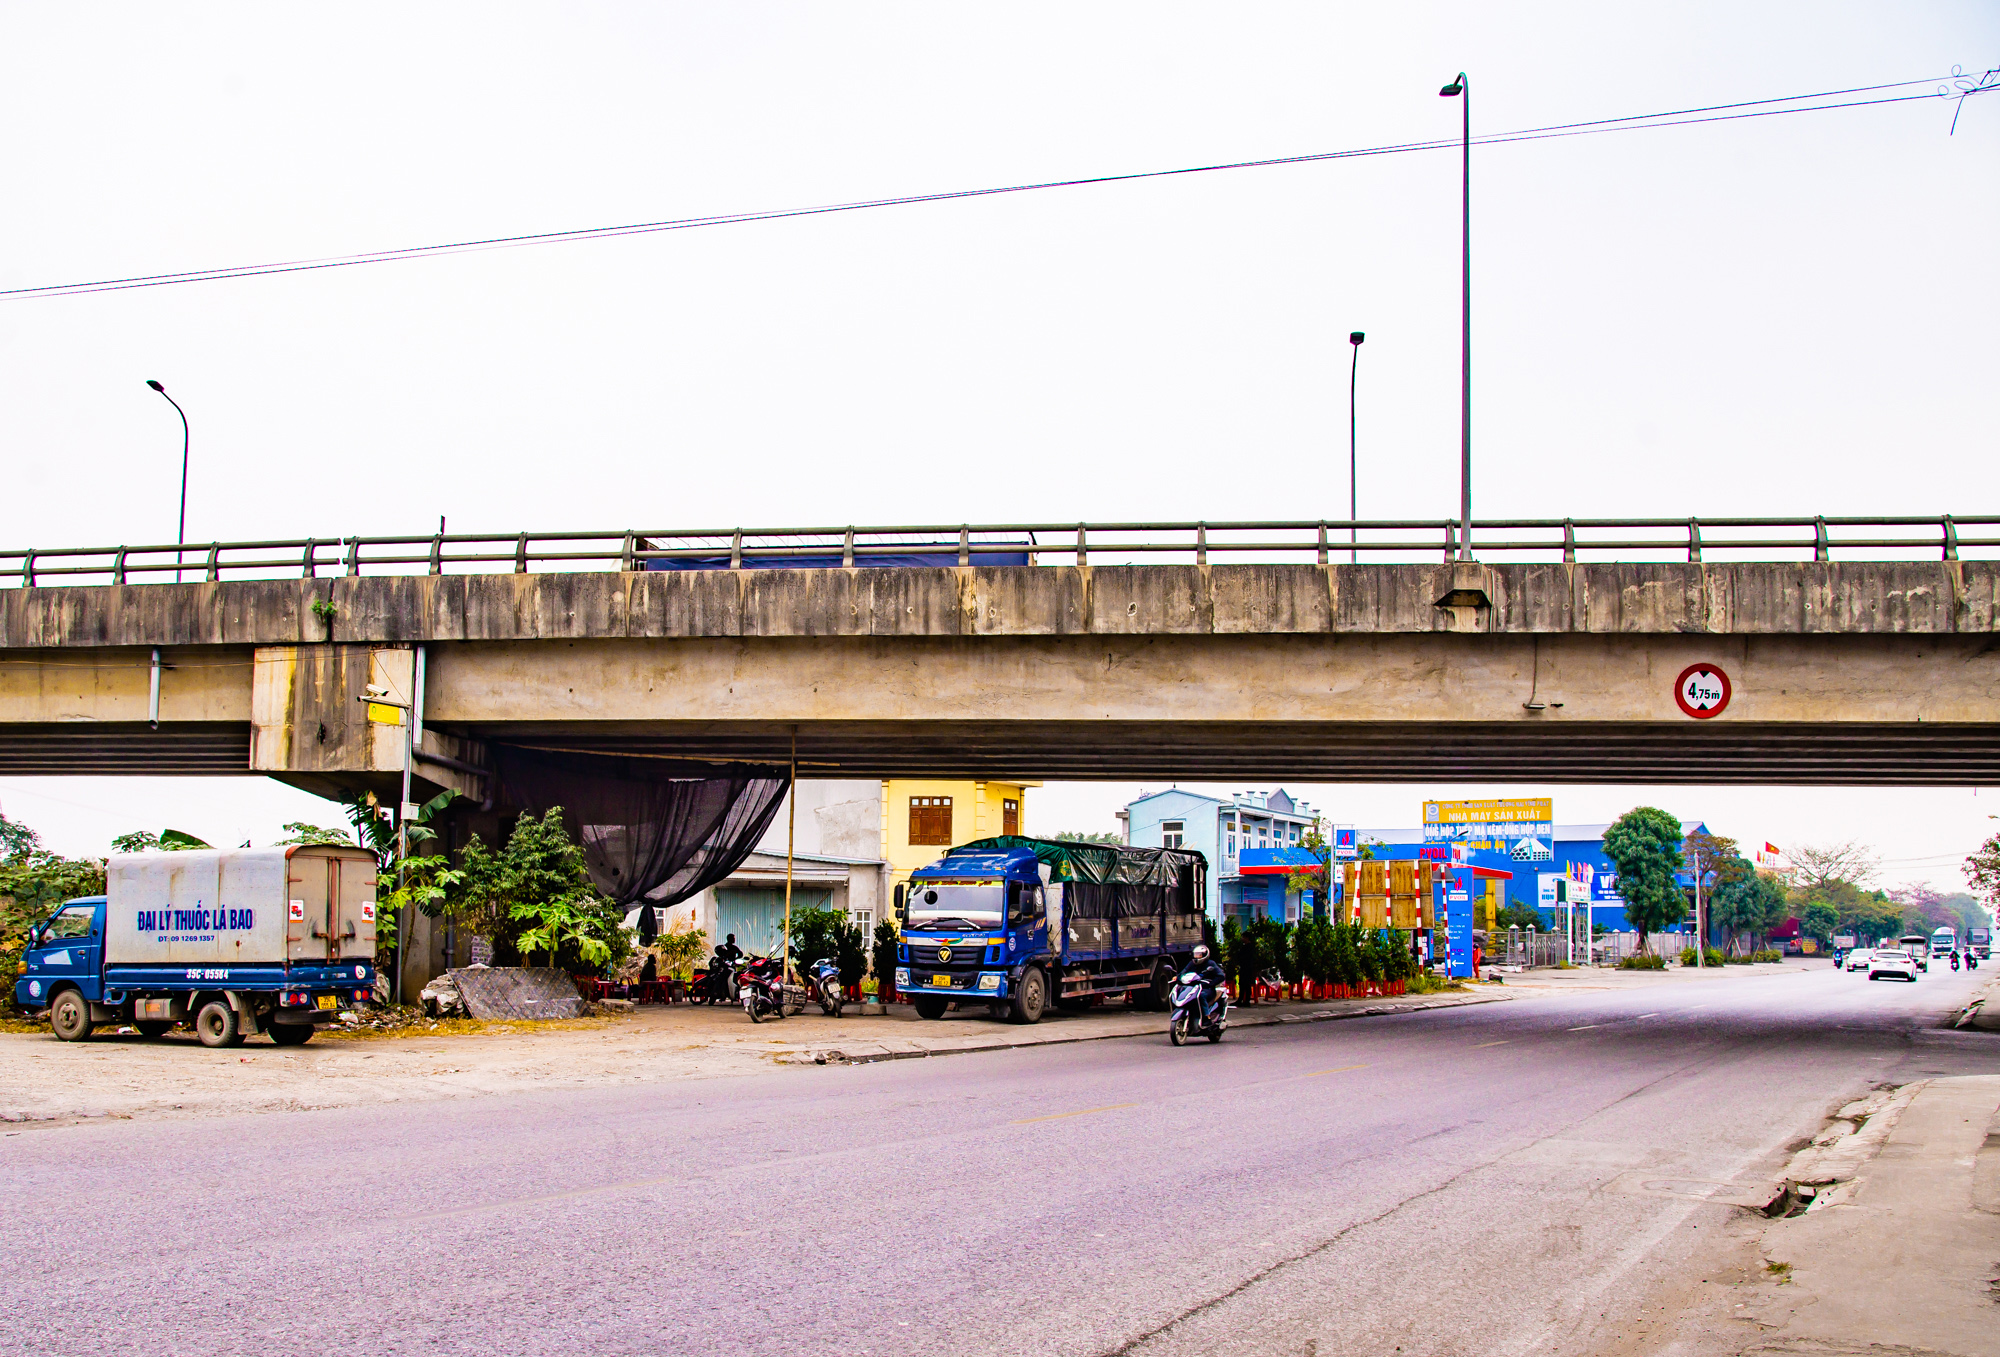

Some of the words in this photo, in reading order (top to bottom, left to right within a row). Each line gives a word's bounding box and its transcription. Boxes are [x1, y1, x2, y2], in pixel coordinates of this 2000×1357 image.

[1420, 848, 1448, 859] PVOIL
[137, 911, 157, 933] ĐẠI
[159, 904, 172, 931] LÝ
[174, 899, 211, 931] THUỐC
[213, 904, 227, 931] LÁ
[229, 908, 254, 931] BAO
[170, 935, 180, 943] 09
[181, 935, 198, 943] 1269
[199, 934, 215, 942] 1357
